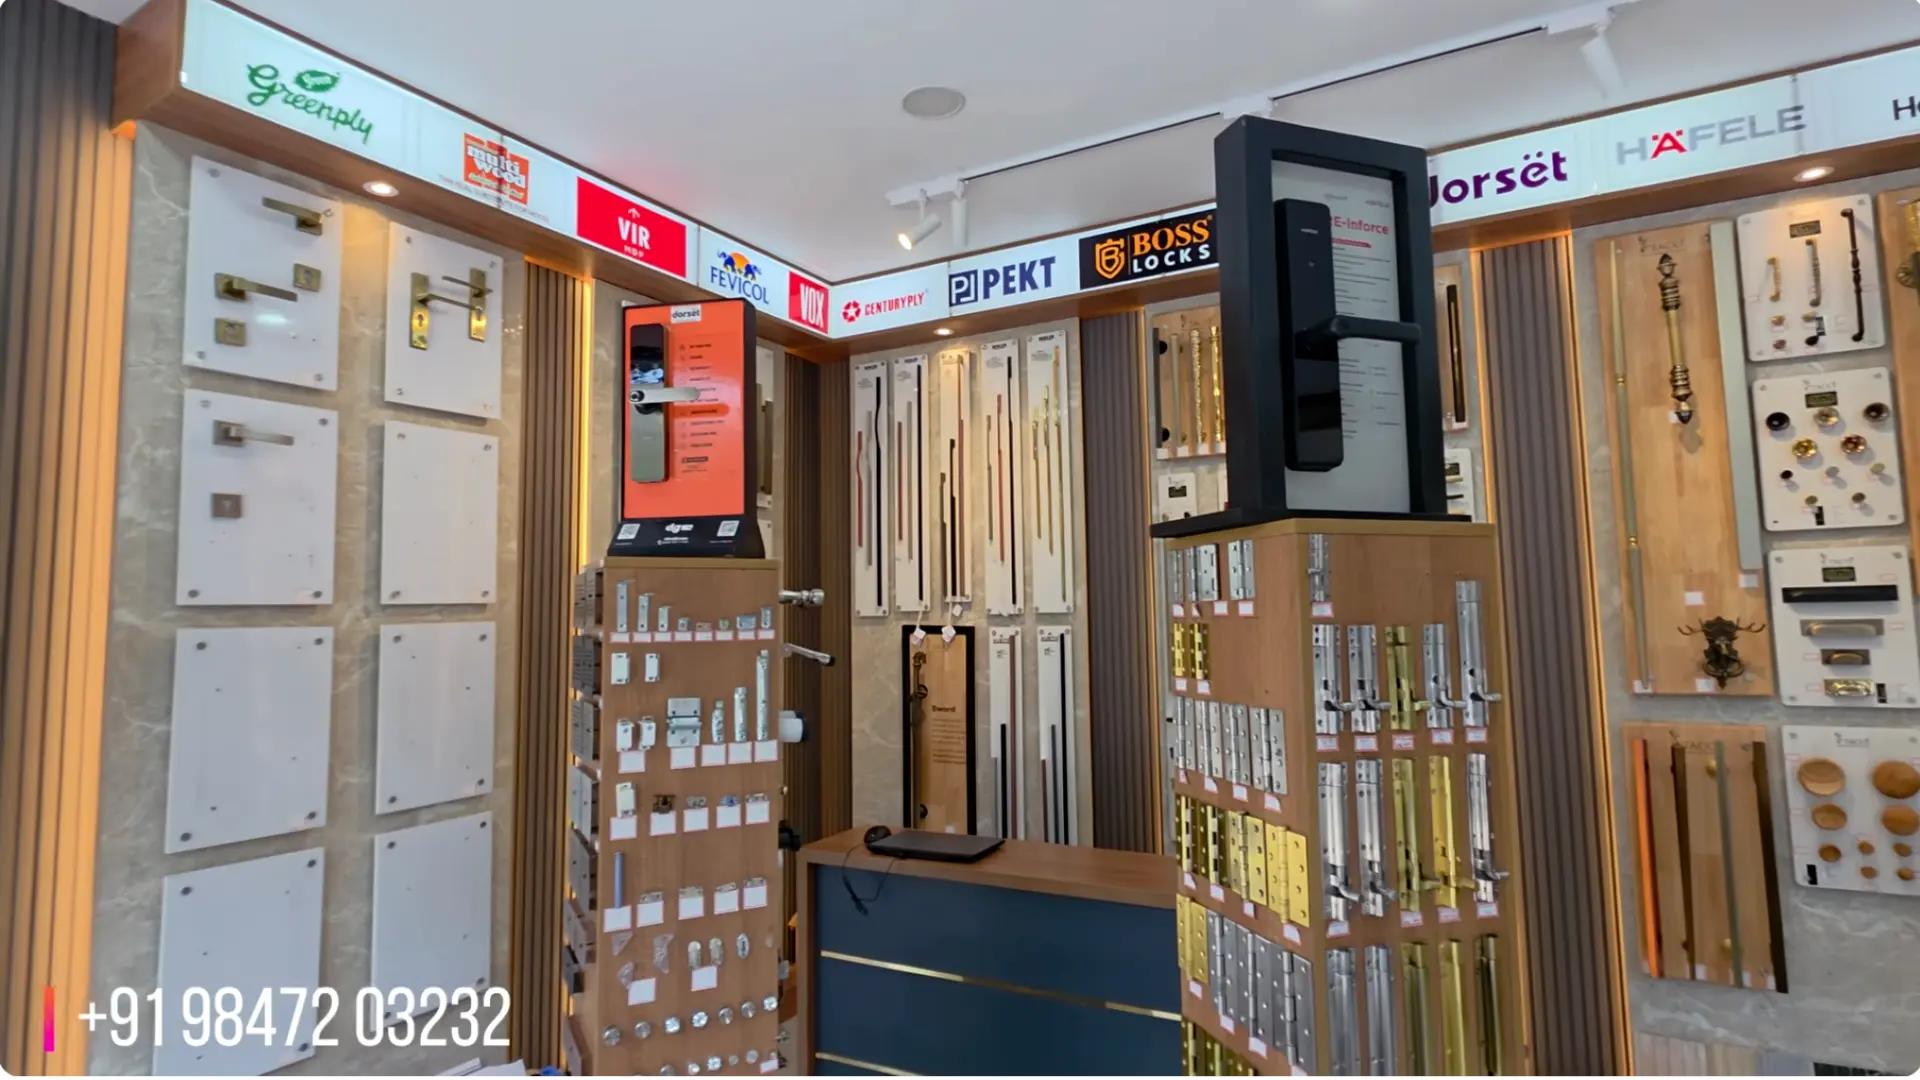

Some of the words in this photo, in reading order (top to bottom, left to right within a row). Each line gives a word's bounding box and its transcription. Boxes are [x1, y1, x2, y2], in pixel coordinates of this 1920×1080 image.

[246, 64, 372, 144] Greenply
[1616, 105, 1806, 165] HÄFELE
[618, 216, 651, 250] VIR
[1131, 219, 1210, 257] BOSS
[982, 255, 1056, 300] PEKT
[1132, 244, 1211, 273] LOCKS
[710, 265, 770, 305] FEVICOL
[864, 291, 925, 316] CENTURYPLY
[800, 283, 824, 328] VOX
